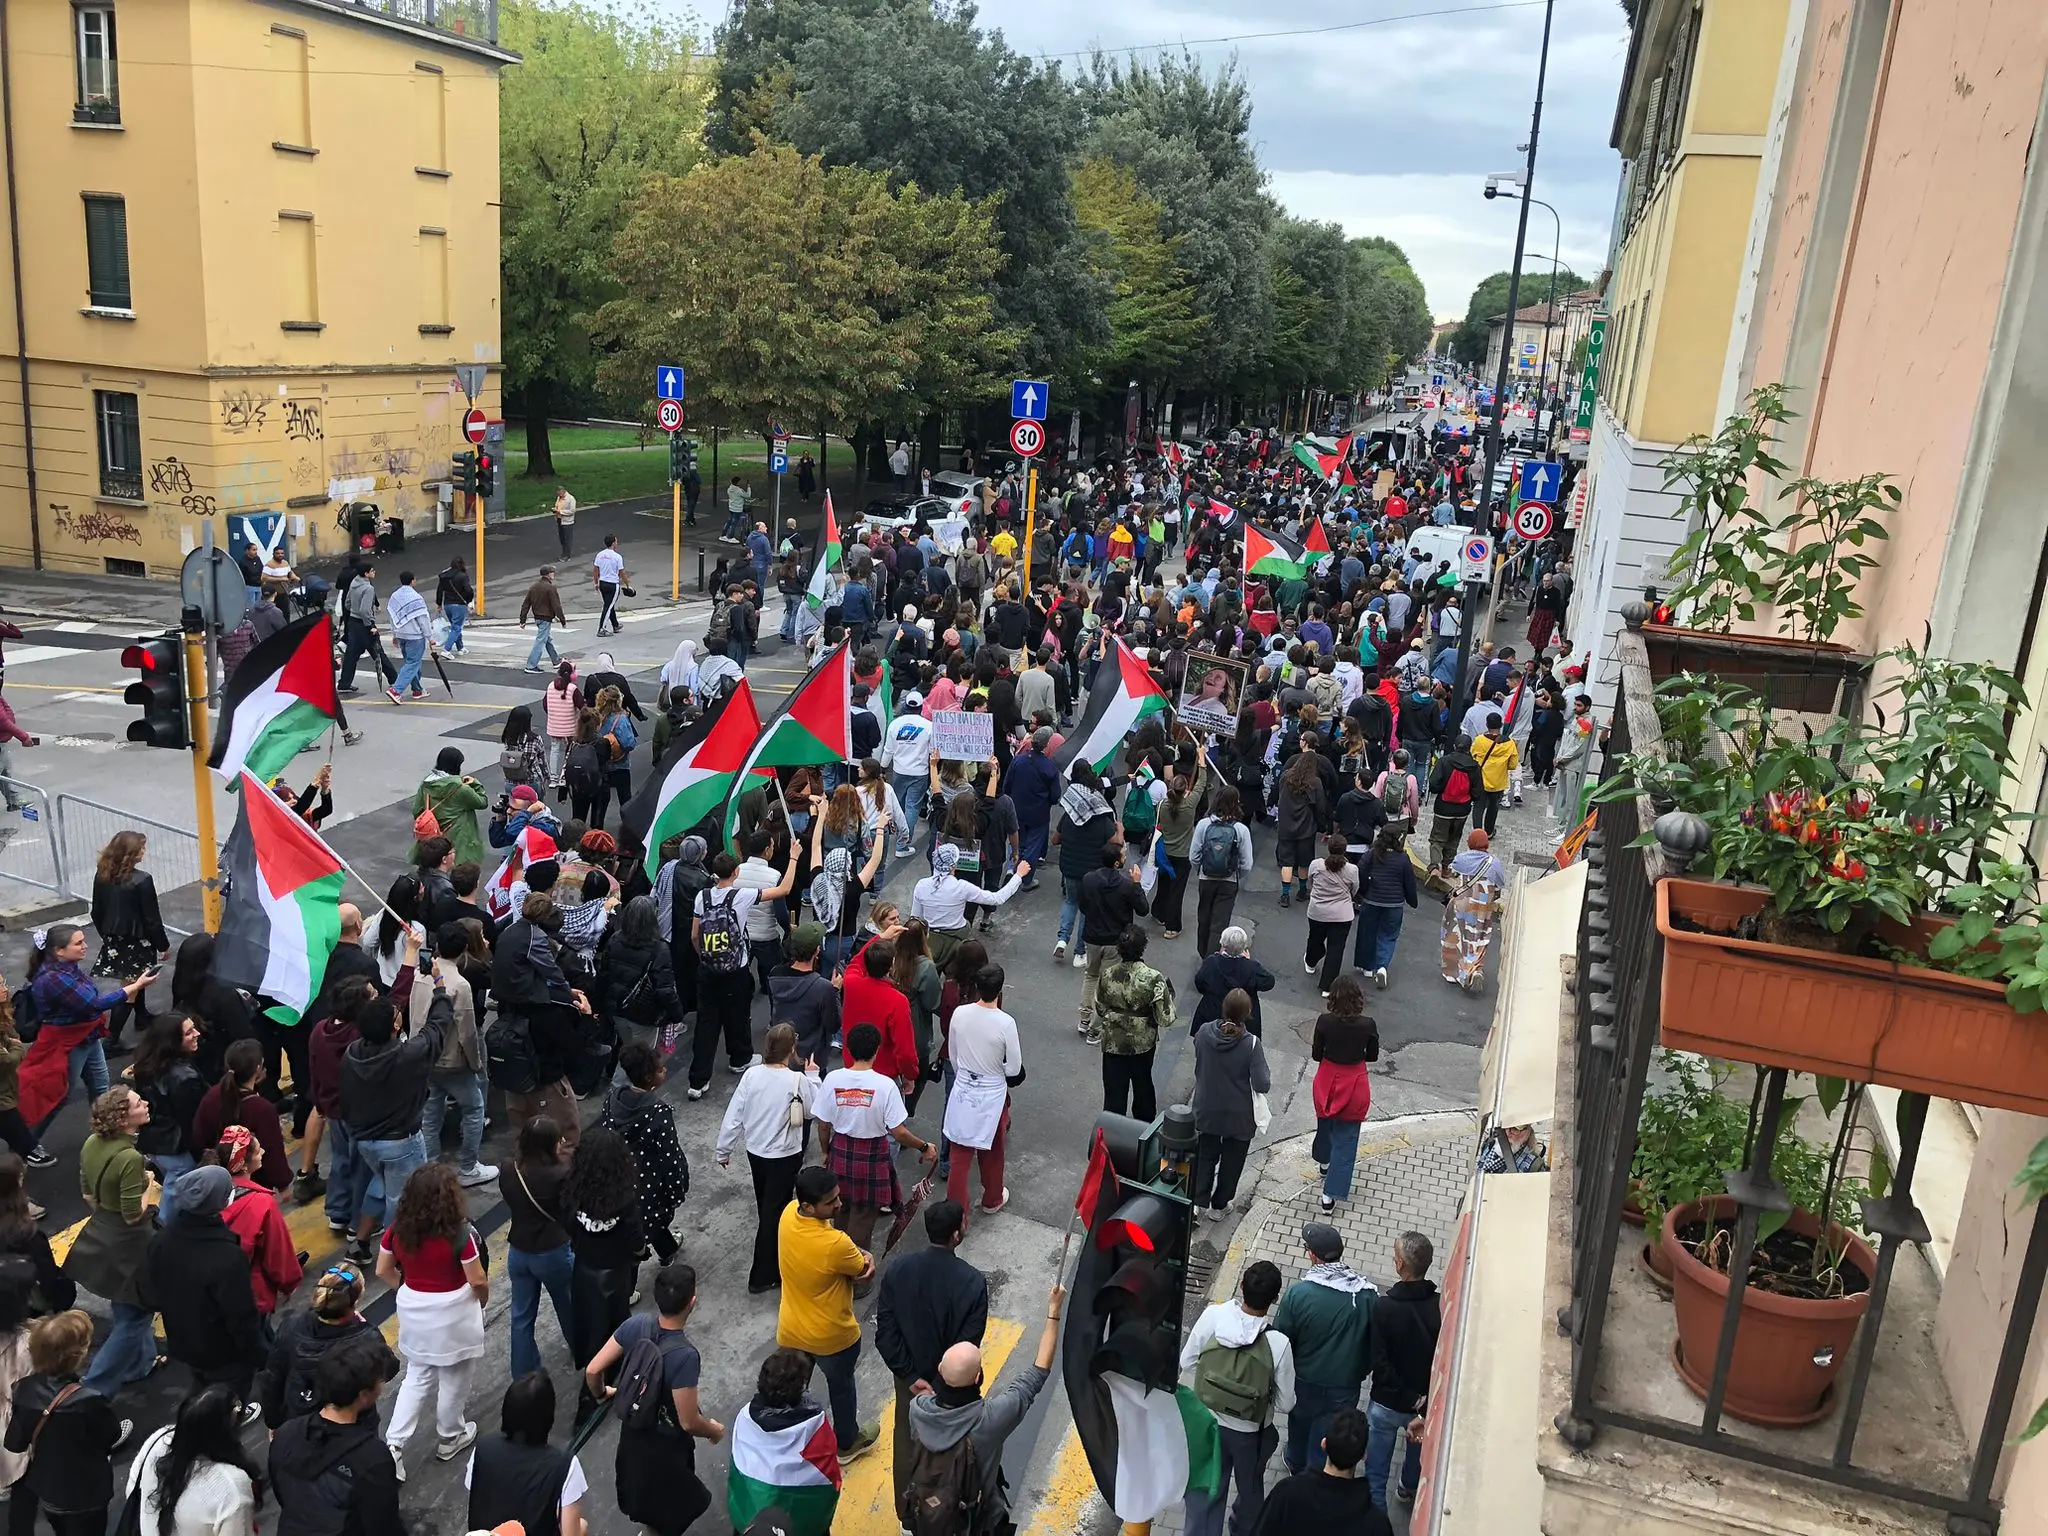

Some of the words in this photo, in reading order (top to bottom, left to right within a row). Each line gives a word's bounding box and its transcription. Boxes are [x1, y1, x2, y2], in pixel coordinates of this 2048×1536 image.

[1579, 329, 1604, 417] OMAR
[663, 407, 677, 423] 30
[1017, 428, 1038, 447] 30
[773, 455, 785, 471] P
[1521, 511, 1544, 530] 30
[934, 711, 969, 724] PALESTINA
[970, 713, 993, 726] LIBERA
[703, 930, 729, 952] YES
